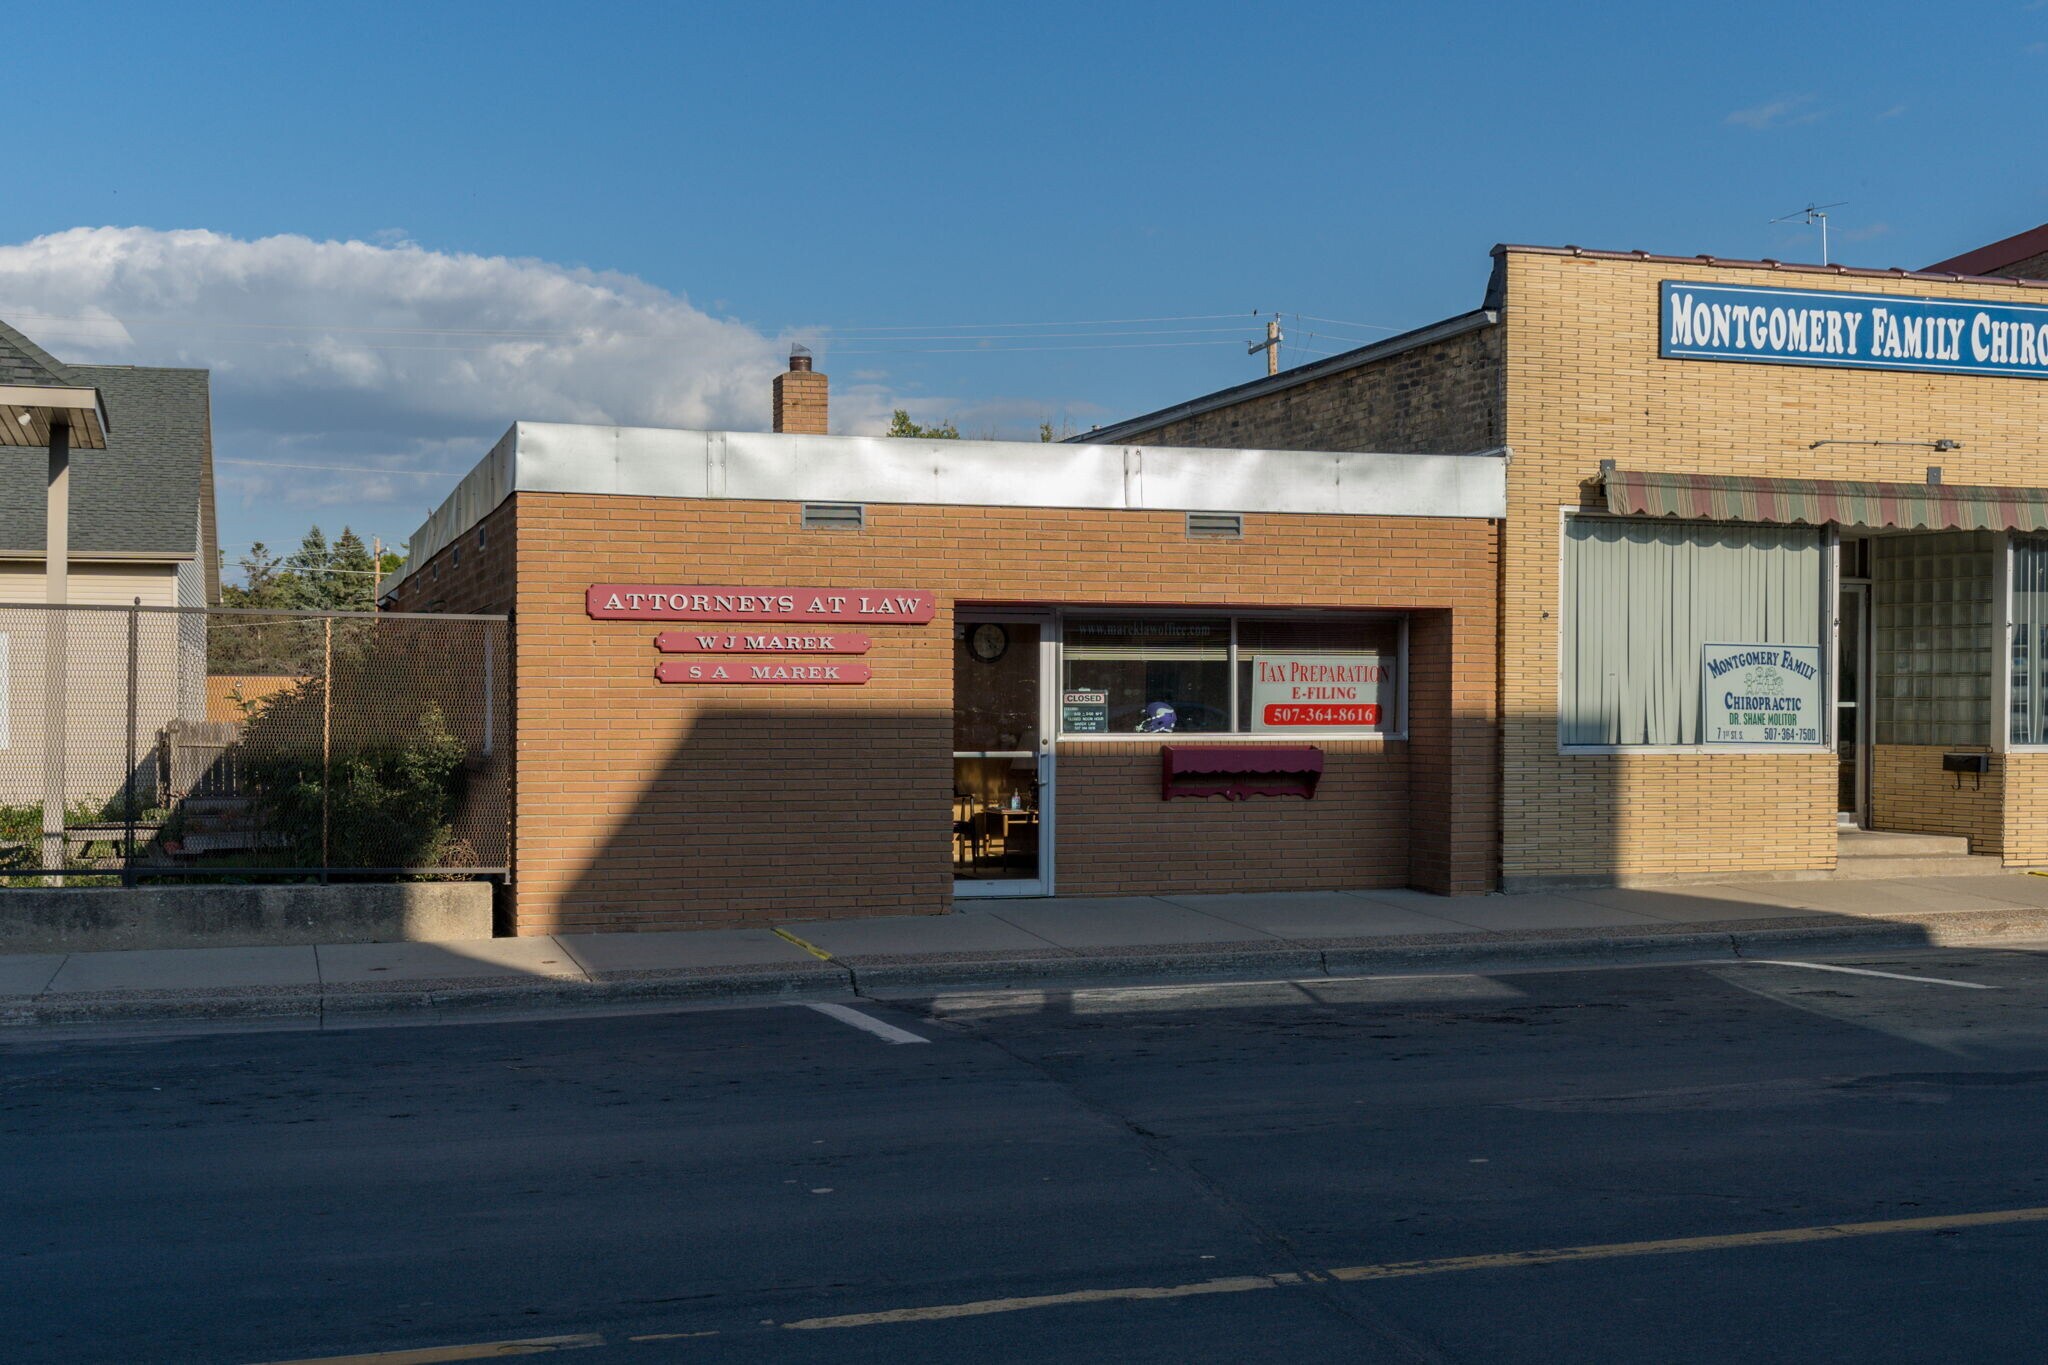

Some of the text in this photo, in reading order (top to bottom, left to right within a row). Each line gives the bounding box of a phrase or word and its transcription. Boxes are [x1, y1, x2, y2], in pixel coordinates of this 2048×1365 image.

[1671, 293, 1862, 355] MONTGOMERY
[1871, 308, 1965, 361] FAMILY
[603, 593, 921, 614] ATTORNEYS AT LAW
[1079, 621, 1211, 636] www.mareklawoffice.com
[697, 636, 835, 650] W J MAREK
[1707, 650, 1817, 680] MONTGOMERY FAMILY
[688, 666, 841, 680] S A MAREK
[1259, 661, 1391, 684] TAX PREPARATION
[1066, 694, 1102, 703] CLOSED
[1291, 687, 1357, 700] E-FILING
[1724, 691, 1802, 711] CHIROPRACTIC
[1273, 708, 1374, 722] 507-364-8616
[1729, 712, 1797, 726] DR. SHANE MOLITOR
[1717, 727, 1721, 740] 7
